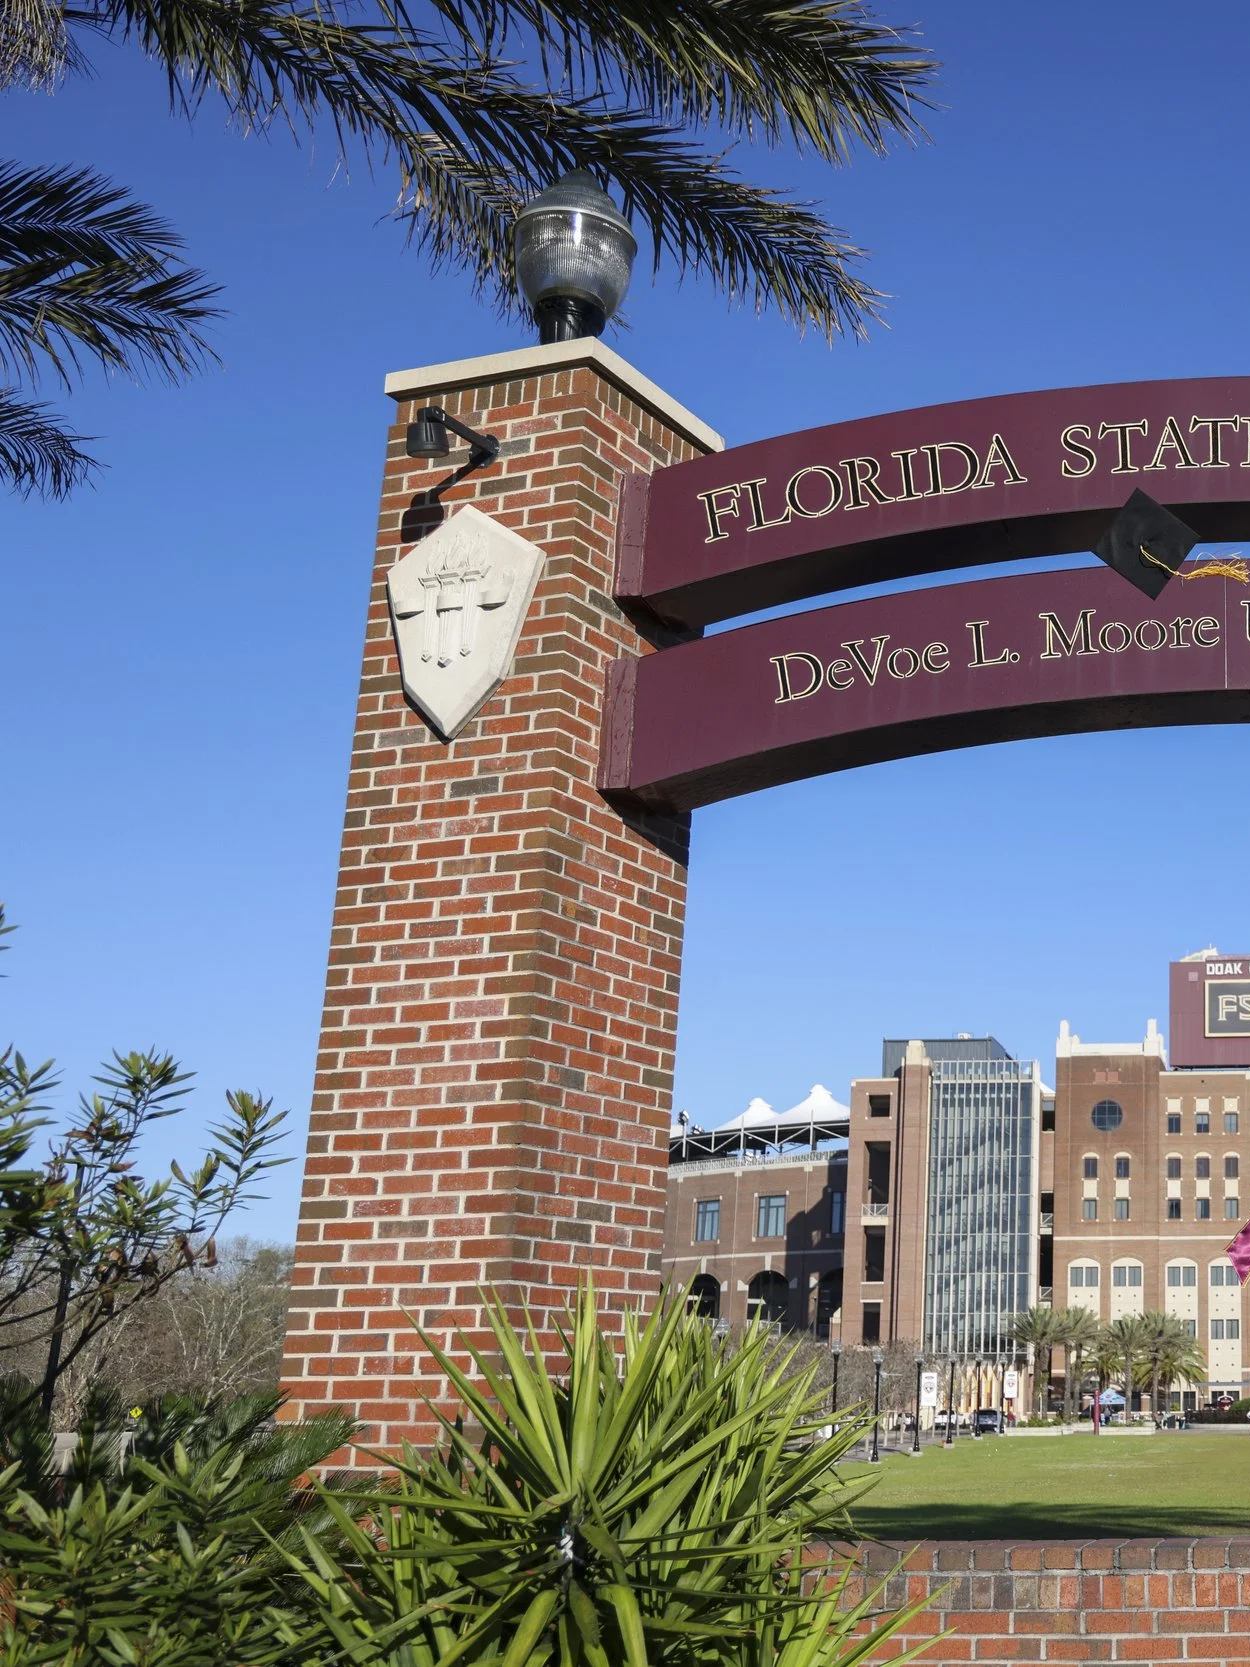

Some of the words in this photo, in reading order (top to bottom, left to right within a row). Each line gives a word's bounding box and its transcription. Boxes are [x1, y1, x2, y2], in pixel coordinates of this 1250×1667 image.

[697, 433, 1027, 543] FLORIDA
[769, 634, 950, 704] DeVoe
[965, 619, 1021, 668] L.
[1038, 608, 1220, 660] Moore
[1206, 963, 1243, 975] DOAK
